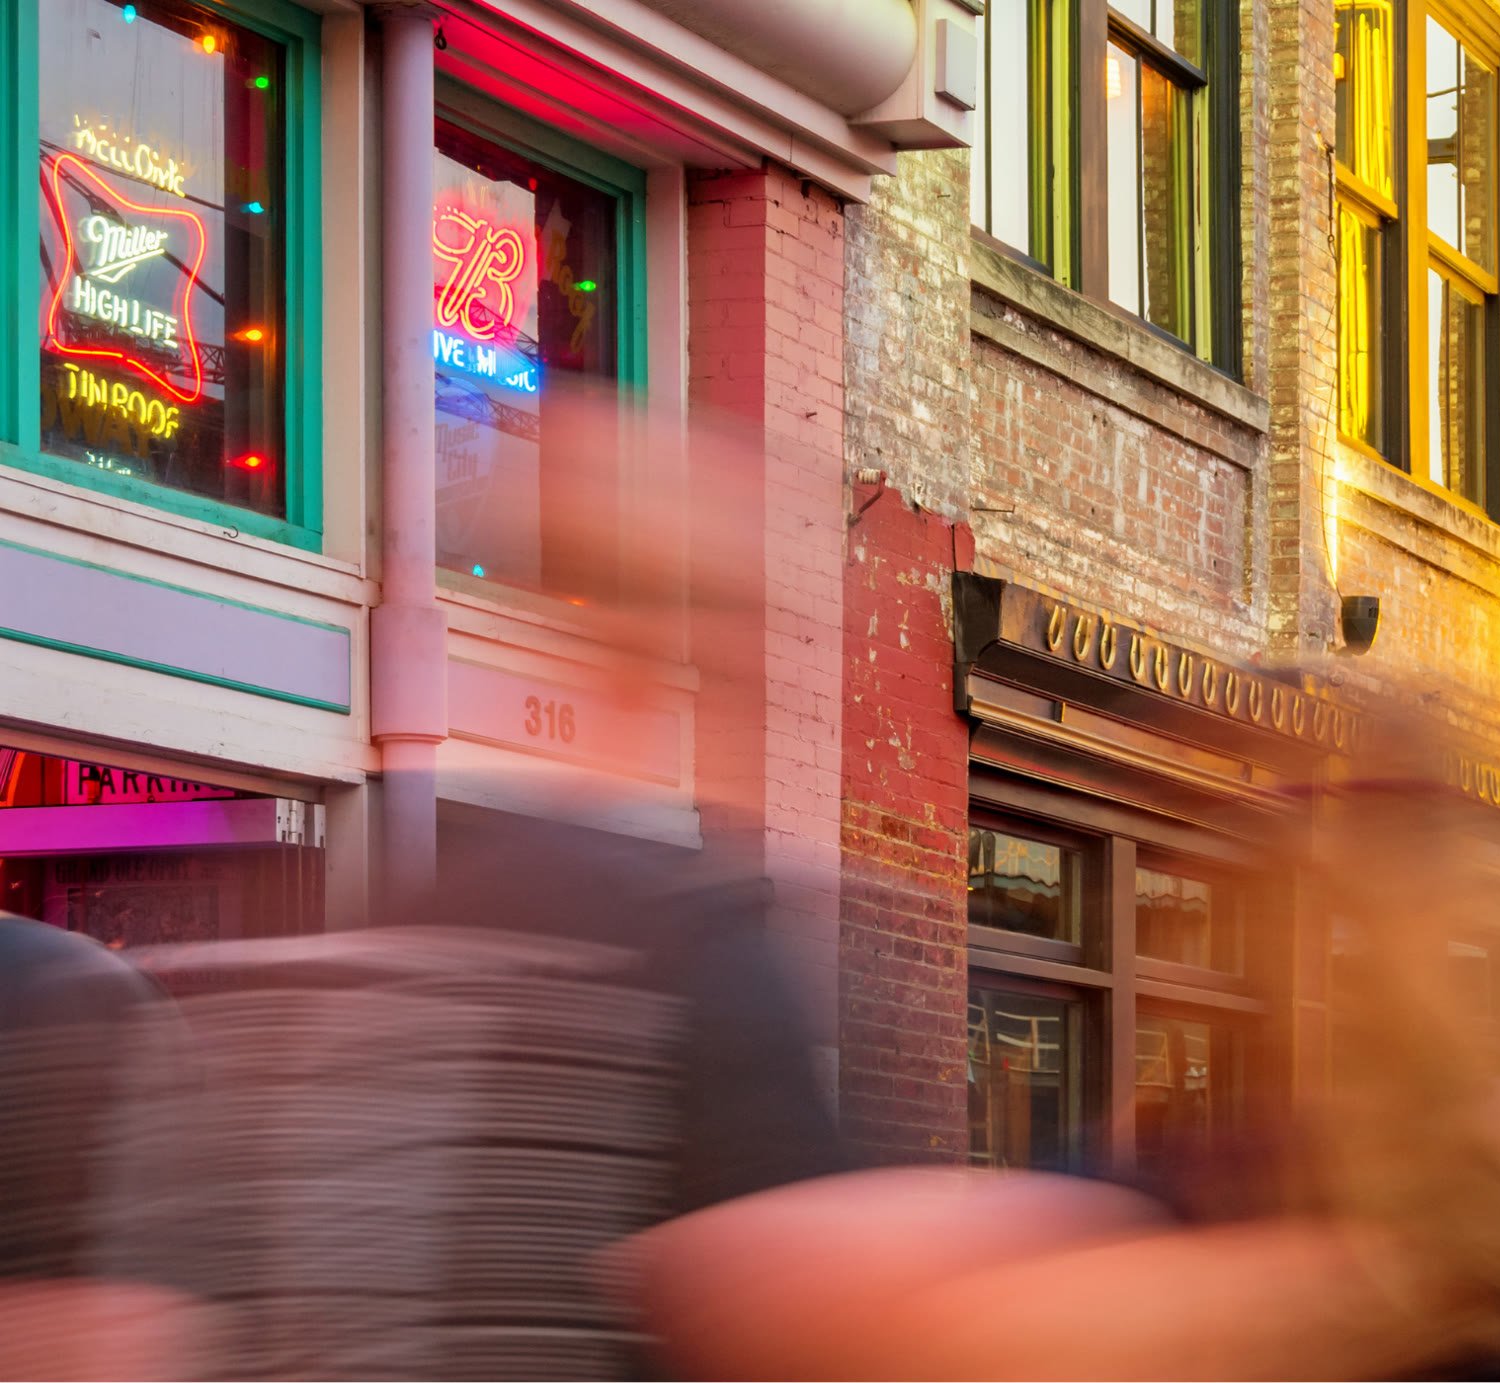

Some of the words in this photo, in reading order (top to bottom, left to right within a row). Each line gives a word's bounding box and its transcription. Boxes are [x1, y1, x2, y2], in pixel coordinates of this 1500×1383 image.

[88, 215, 169, 266] Miller
[73, 275, 128, 328] HIGH
[131, 299, 179, 348] LIFE
[433, 330, 464, 367] IVE
[476, 345, 537, 392] MIC
[63, 362, 108, 411] TIN
[111, 382, 180, 439] ROOF
[525, 695, 576, 744] 316
[79, 762, 214, 795] PARK
